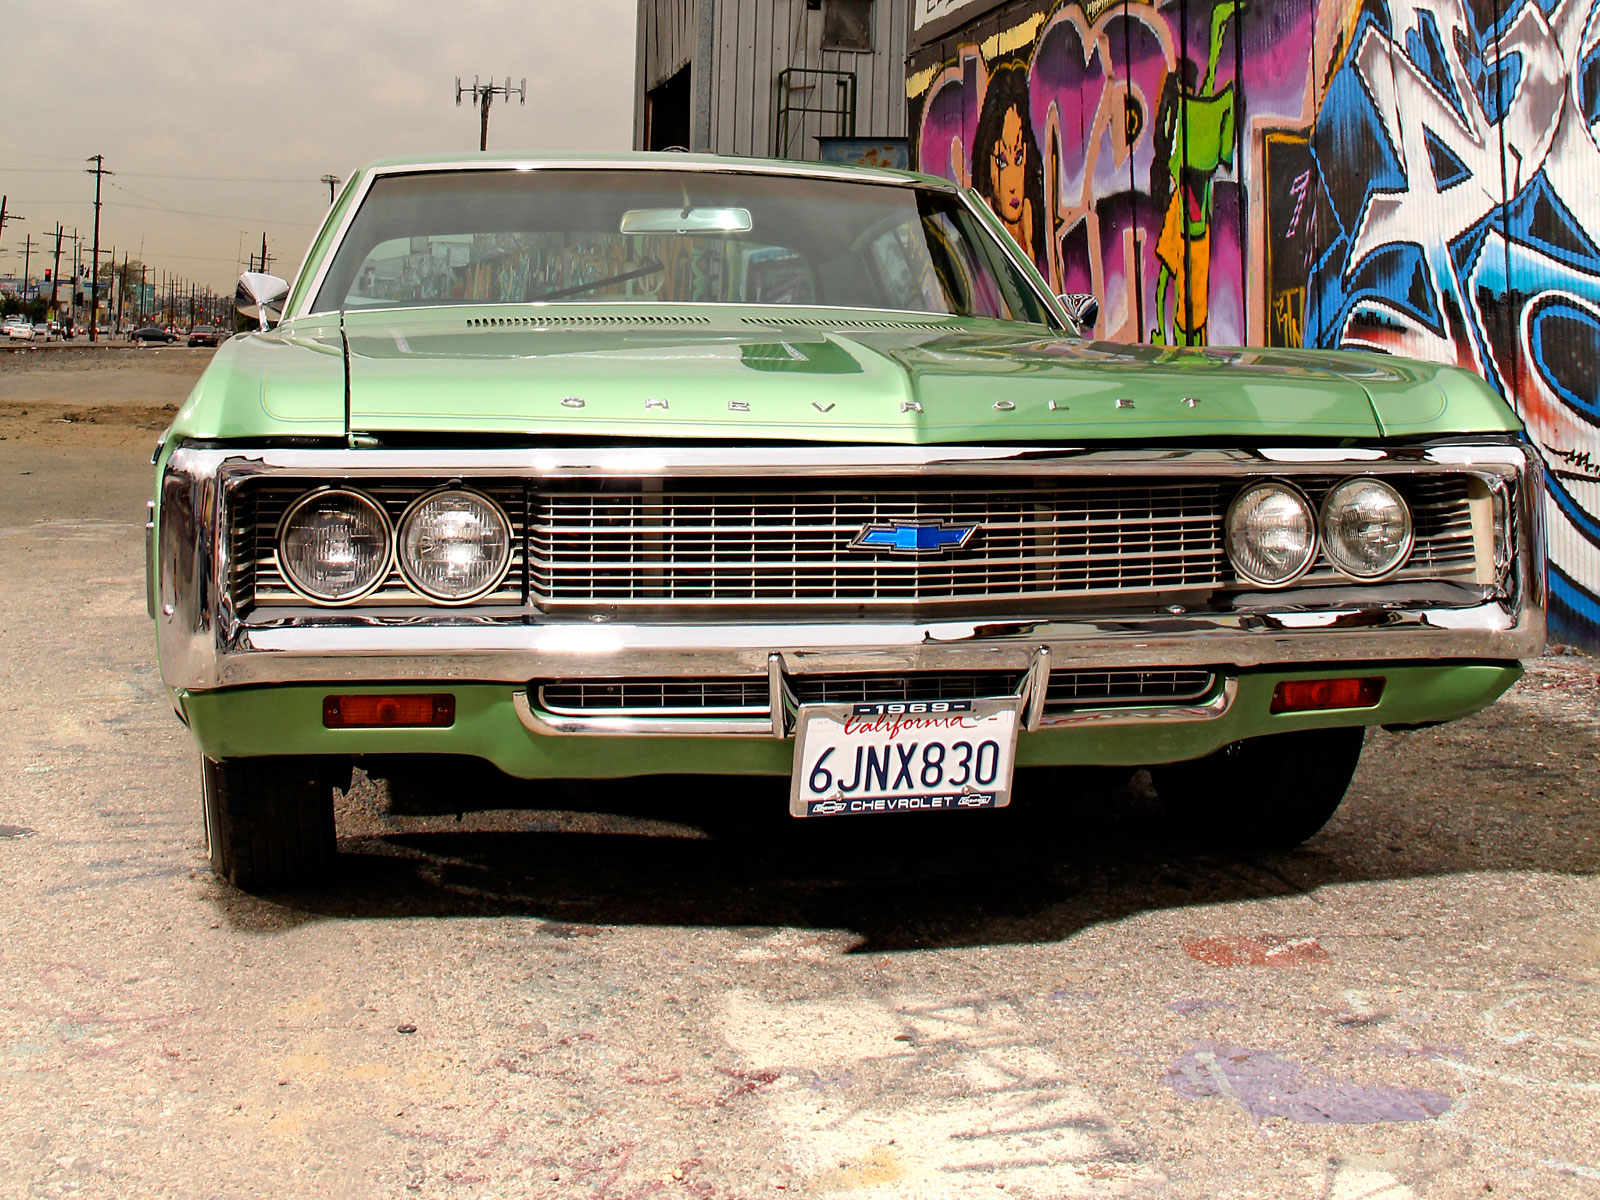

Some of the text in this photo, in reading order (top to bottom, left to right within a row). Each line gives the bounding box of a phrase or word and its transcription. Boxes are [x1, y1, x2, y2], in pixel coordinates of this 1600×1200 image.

[560, 396, 1201, 414] CHEVROLET
[844, 714, 977, 740] California
[808, 739, 1000, 793] 6JNX830
[850, 796, 954, 811] CHEVROLET
